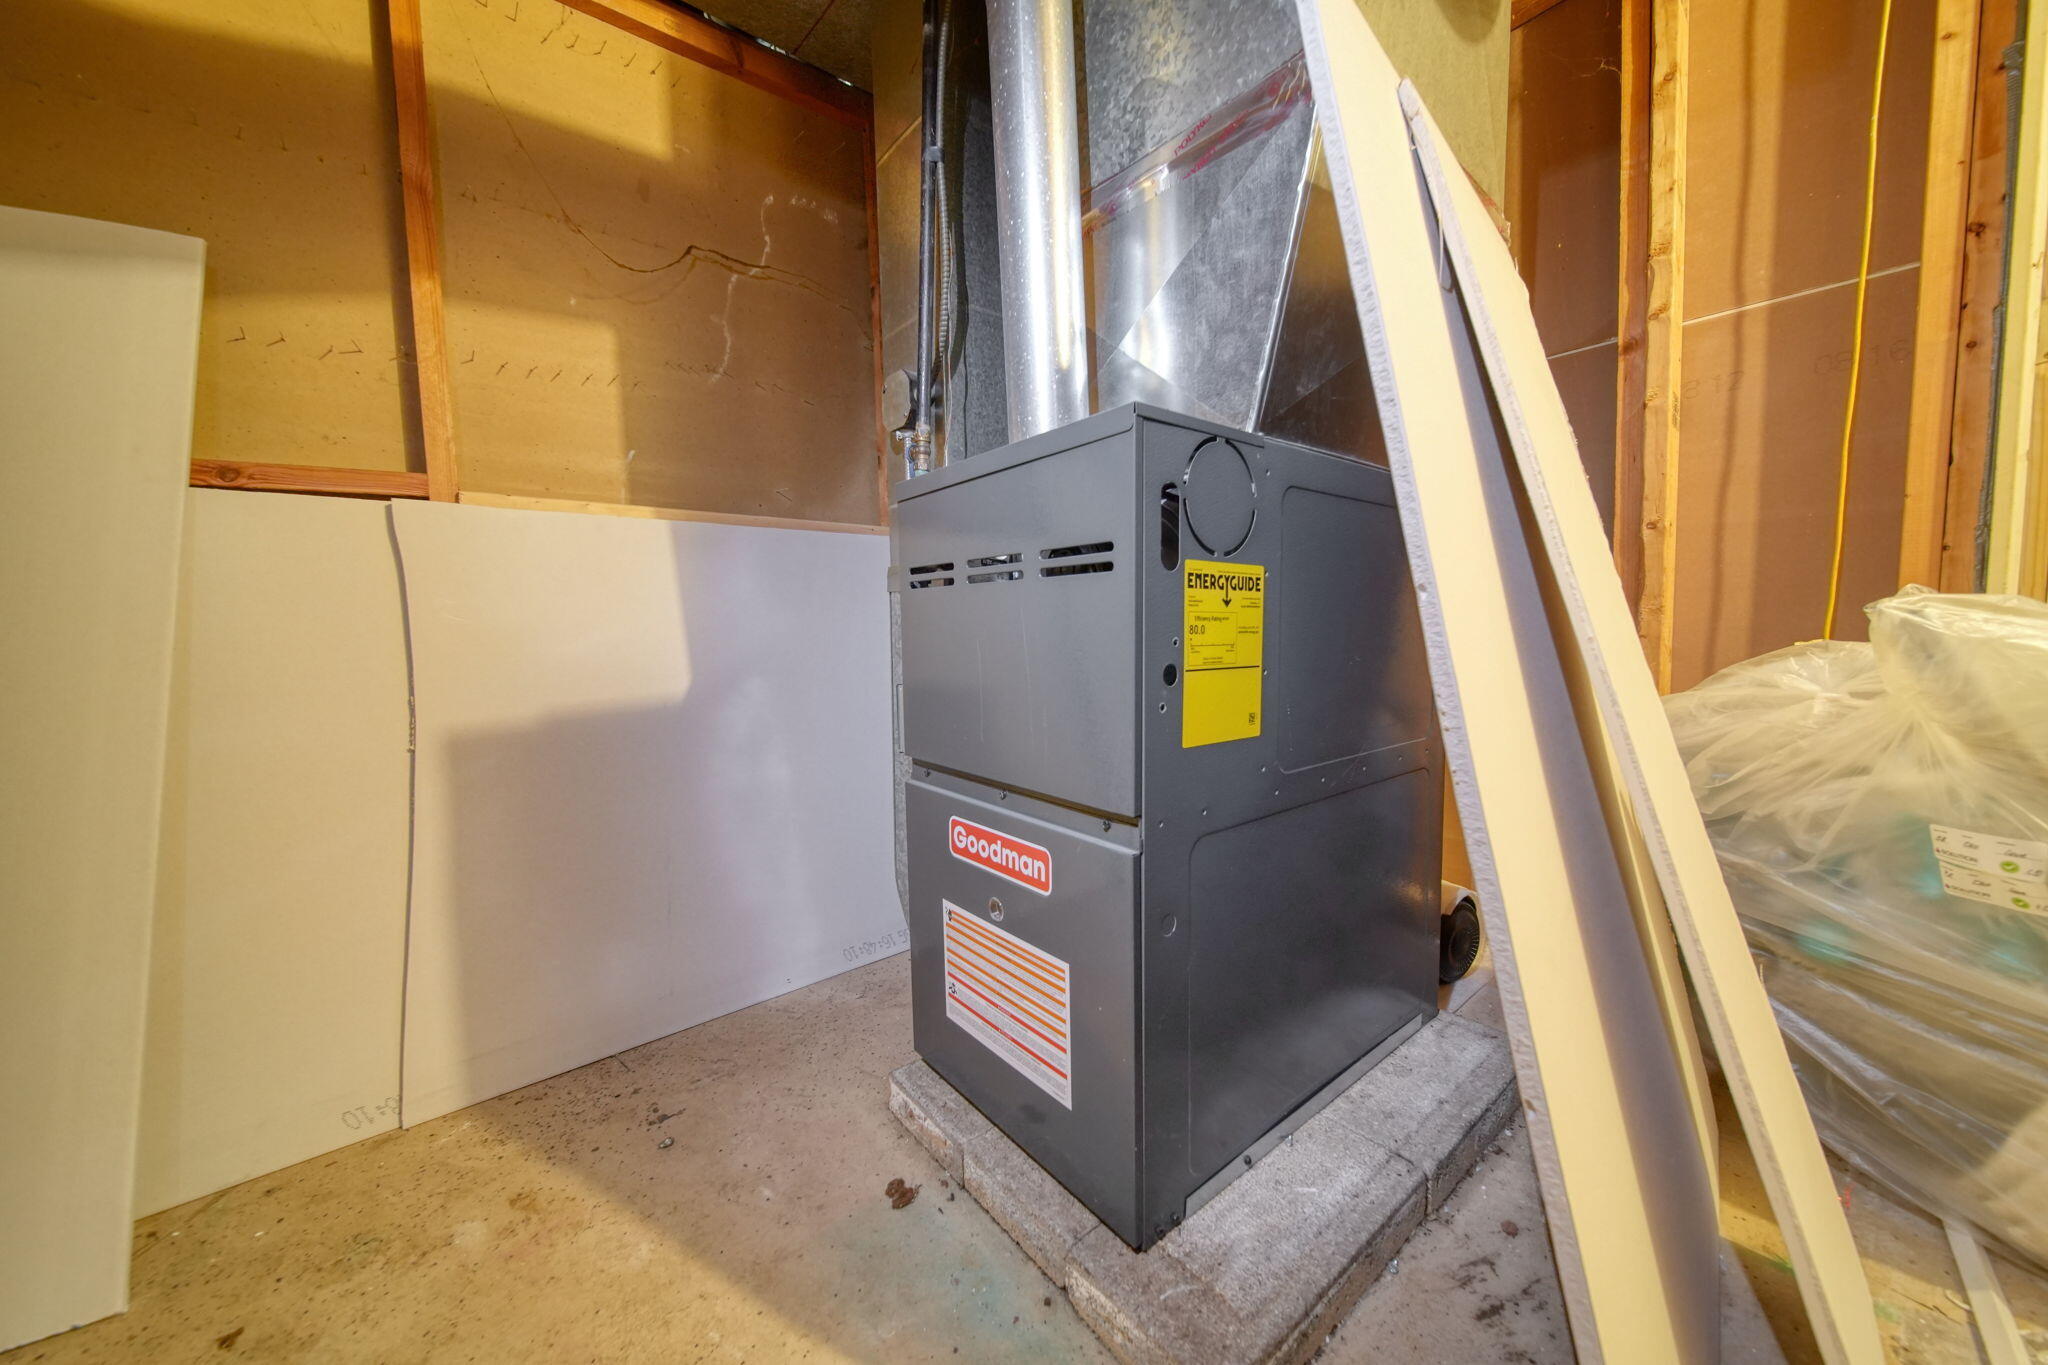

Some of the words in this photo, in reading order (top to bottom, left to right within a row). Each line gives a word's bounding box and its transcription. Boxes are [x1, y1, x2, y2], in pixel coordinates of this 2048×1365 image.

[1187, 572, 1261, 592] ENERGYGUIDE
[1189, 624, 1206, 635] 80.0
[953, 825, 1046, 882] Goodman
